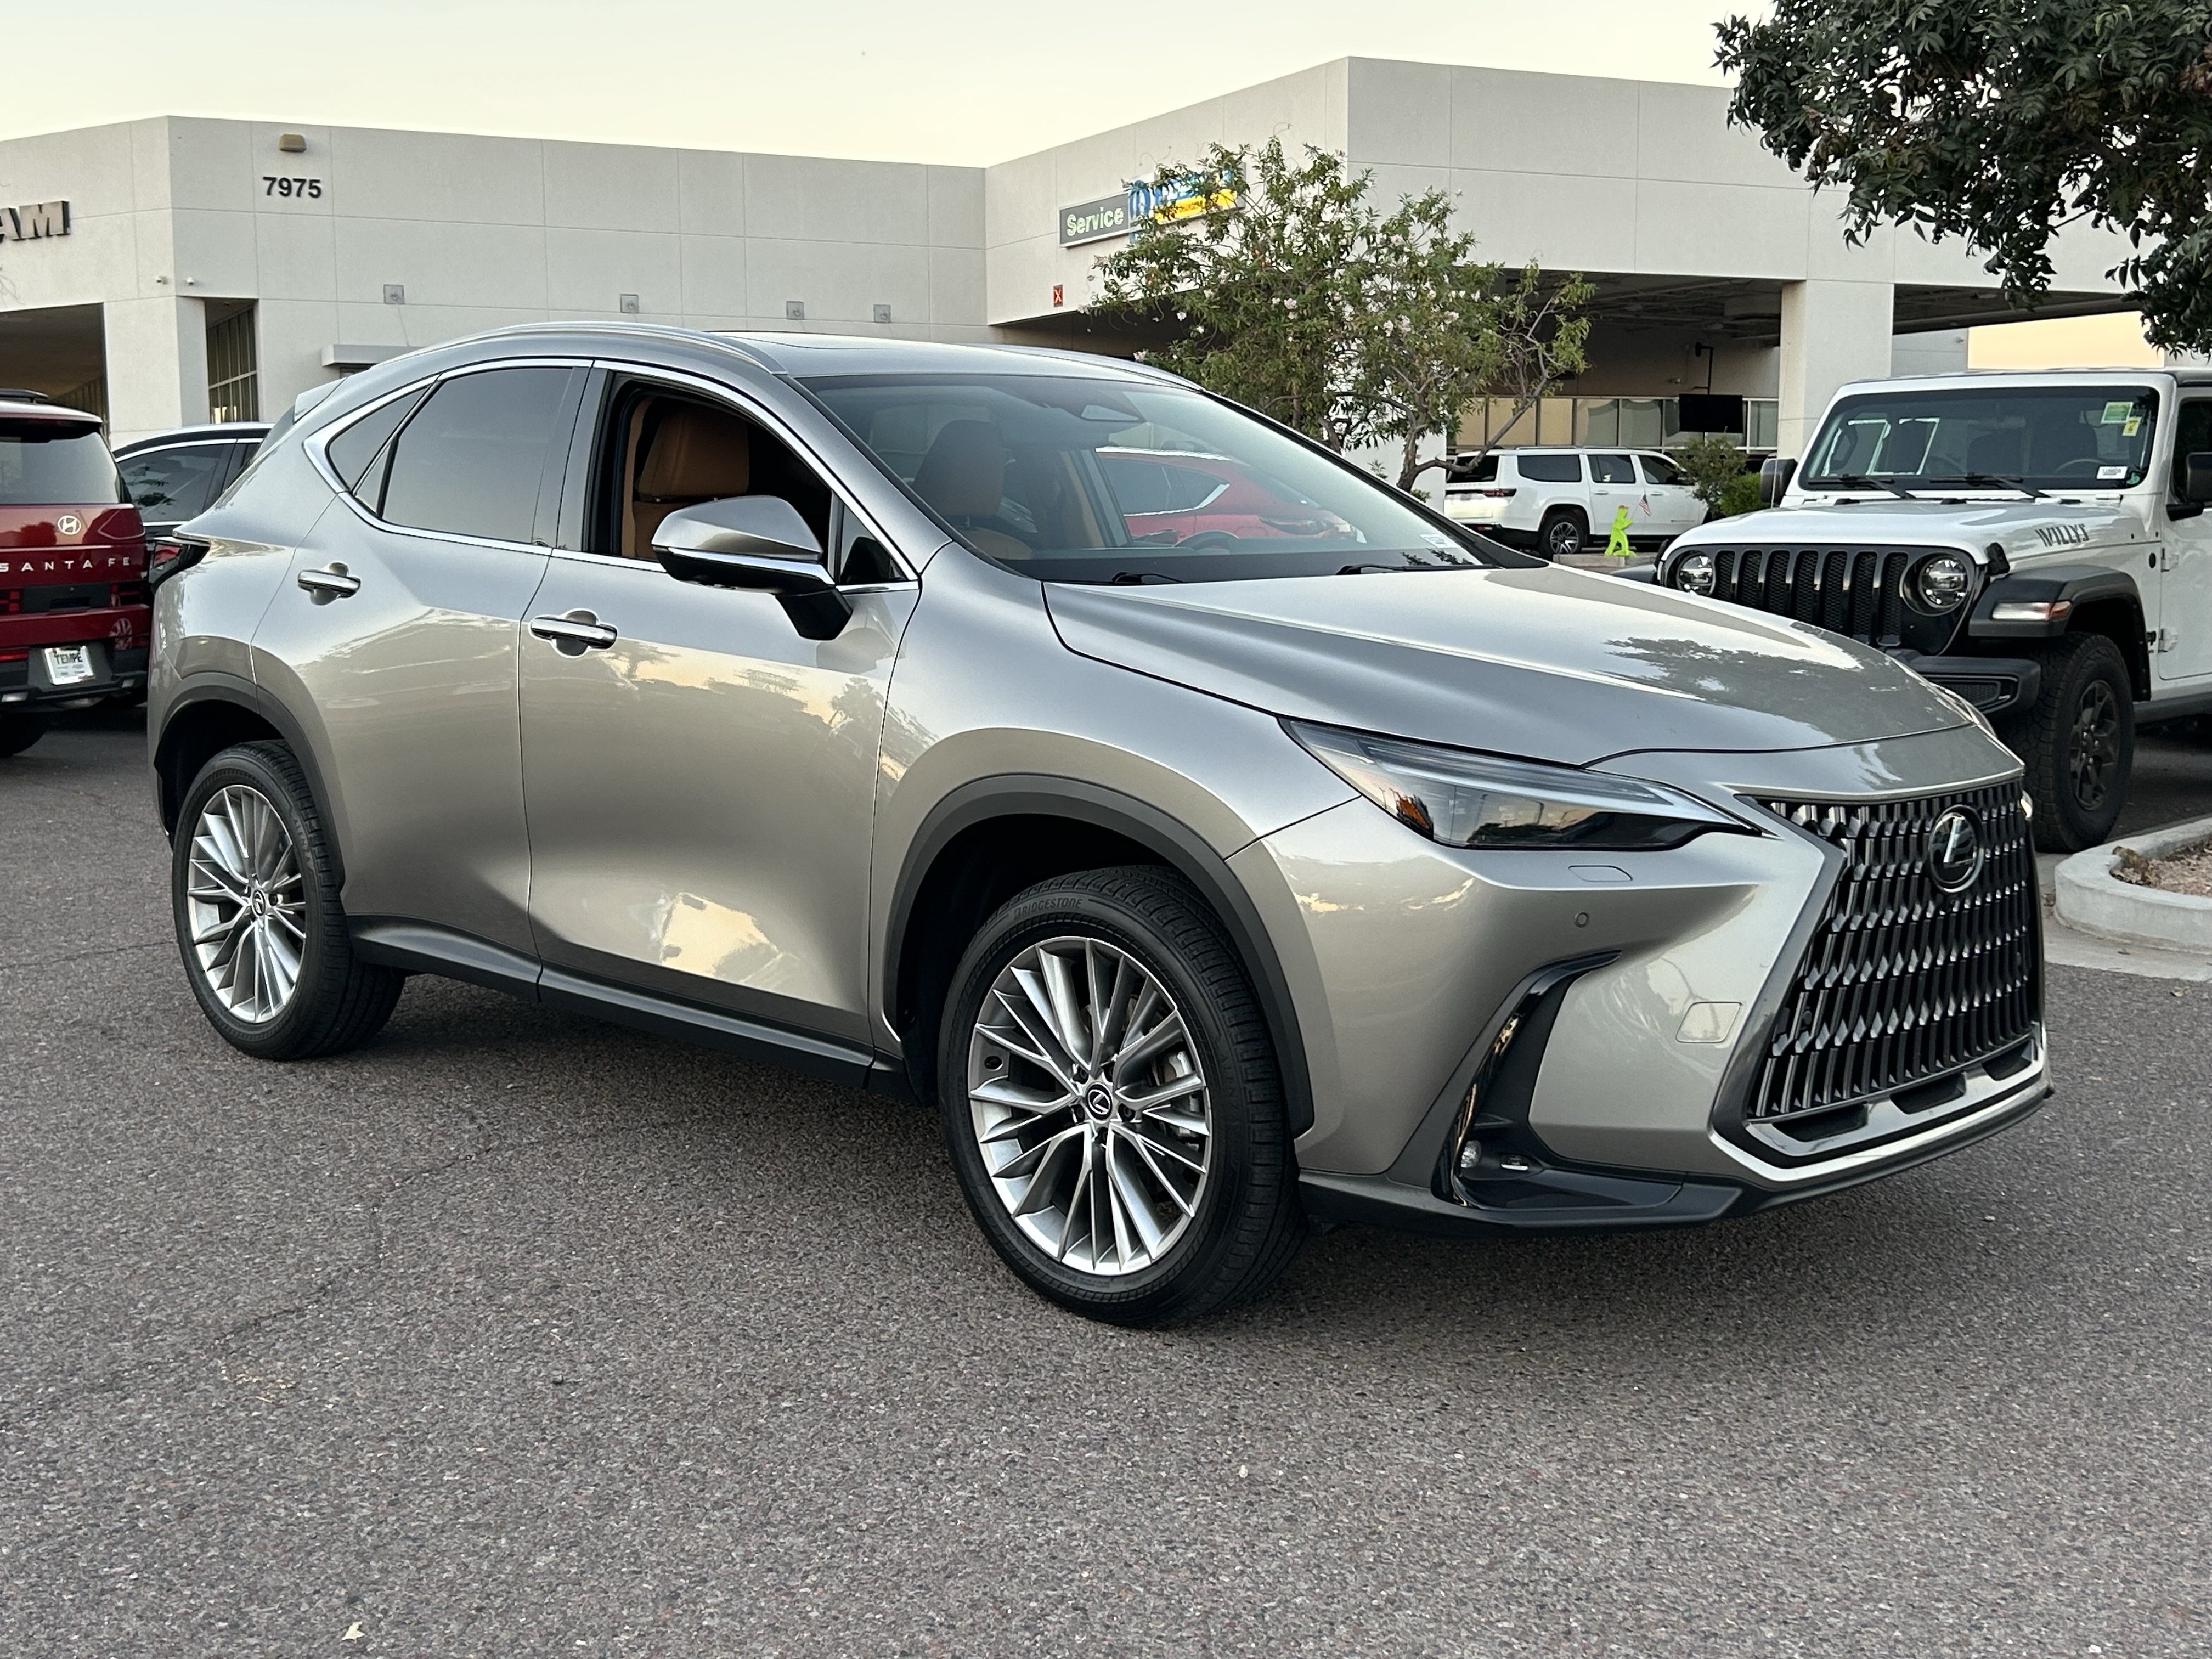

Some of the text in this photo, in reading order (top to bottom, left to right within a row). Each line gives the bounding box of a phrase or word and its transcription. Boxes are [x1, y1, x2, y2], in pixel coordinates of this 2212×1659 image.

[263, 176, 321, 198] 7975
[1066, 206, 1124, 236] Service
[2035, 523, 2089, 547] WILLYS
[0, 557, 129, 573] SANTA FE
[1014, 897, 1084, 921] BRIDGESTONE
